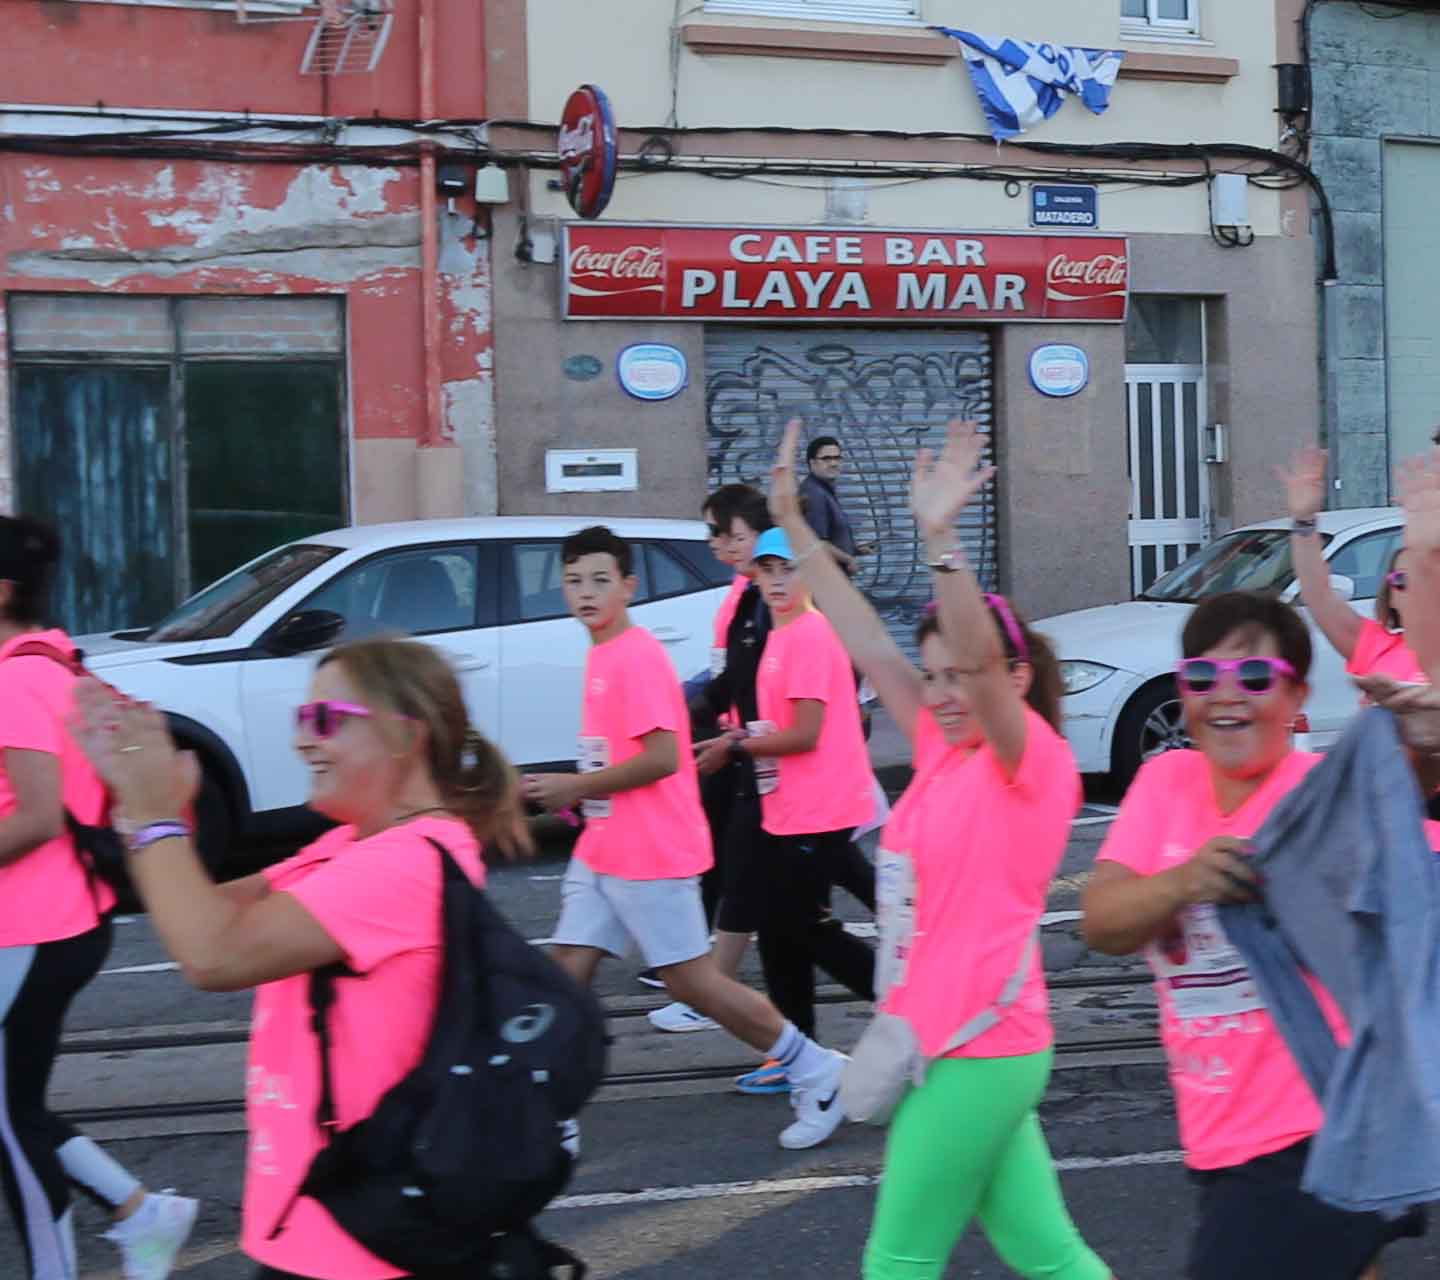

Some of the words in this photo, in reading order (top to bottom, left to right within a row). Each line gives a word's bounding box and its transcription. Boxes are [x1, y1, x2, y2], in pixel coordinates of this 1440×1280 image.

[1035, 211, 1094, 224] MATADERO
[568, 245, 664, 278] Coca-Cola
[729, 233, 864, 265] CAFE
[885, 238, 987, 267] BAR
[1046, 254, 1127, 286] Coca-Cola
[681, 269, 872, 310] PLAYA
[895, 272, 1027, 311] MAR
